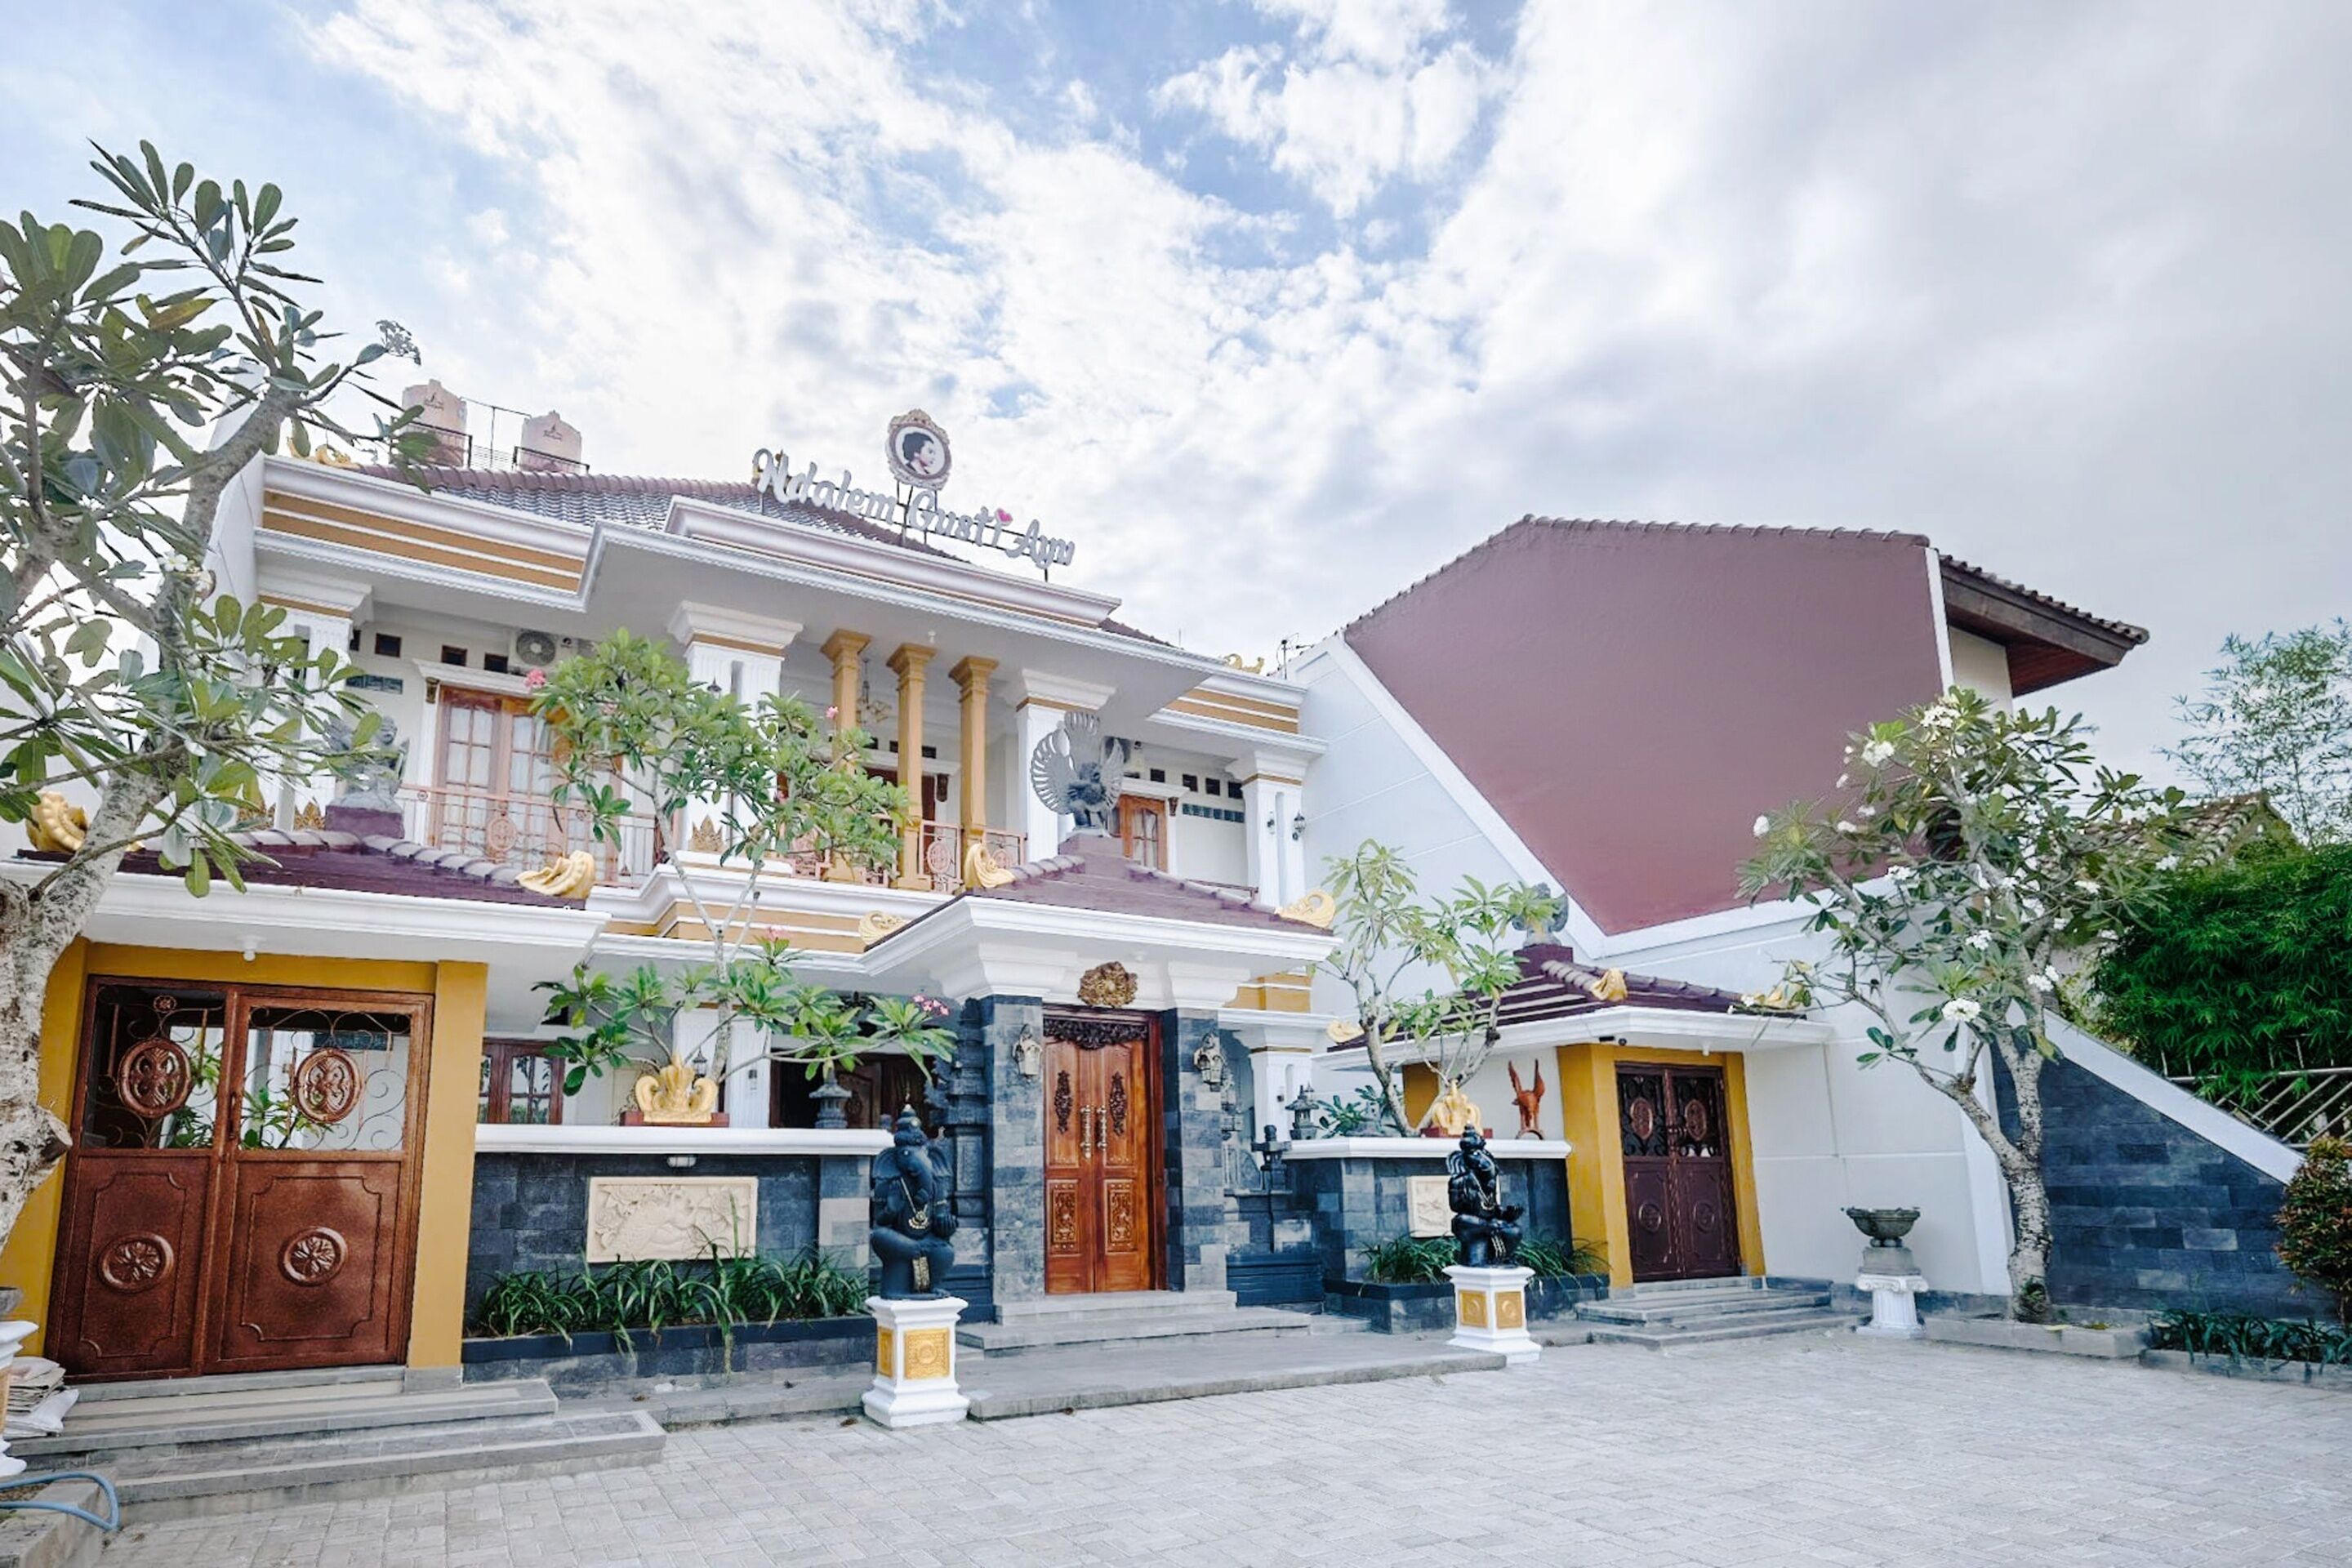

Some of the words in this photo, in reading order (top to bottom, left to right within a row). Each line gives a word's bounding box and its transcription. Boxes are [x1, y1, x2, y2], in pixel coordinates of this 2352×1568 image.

[752, 448, 895, 524] Ndalem
[908, 491, 1013, 547] Gusti
[1005, 519, 1076, 569] Ayu
